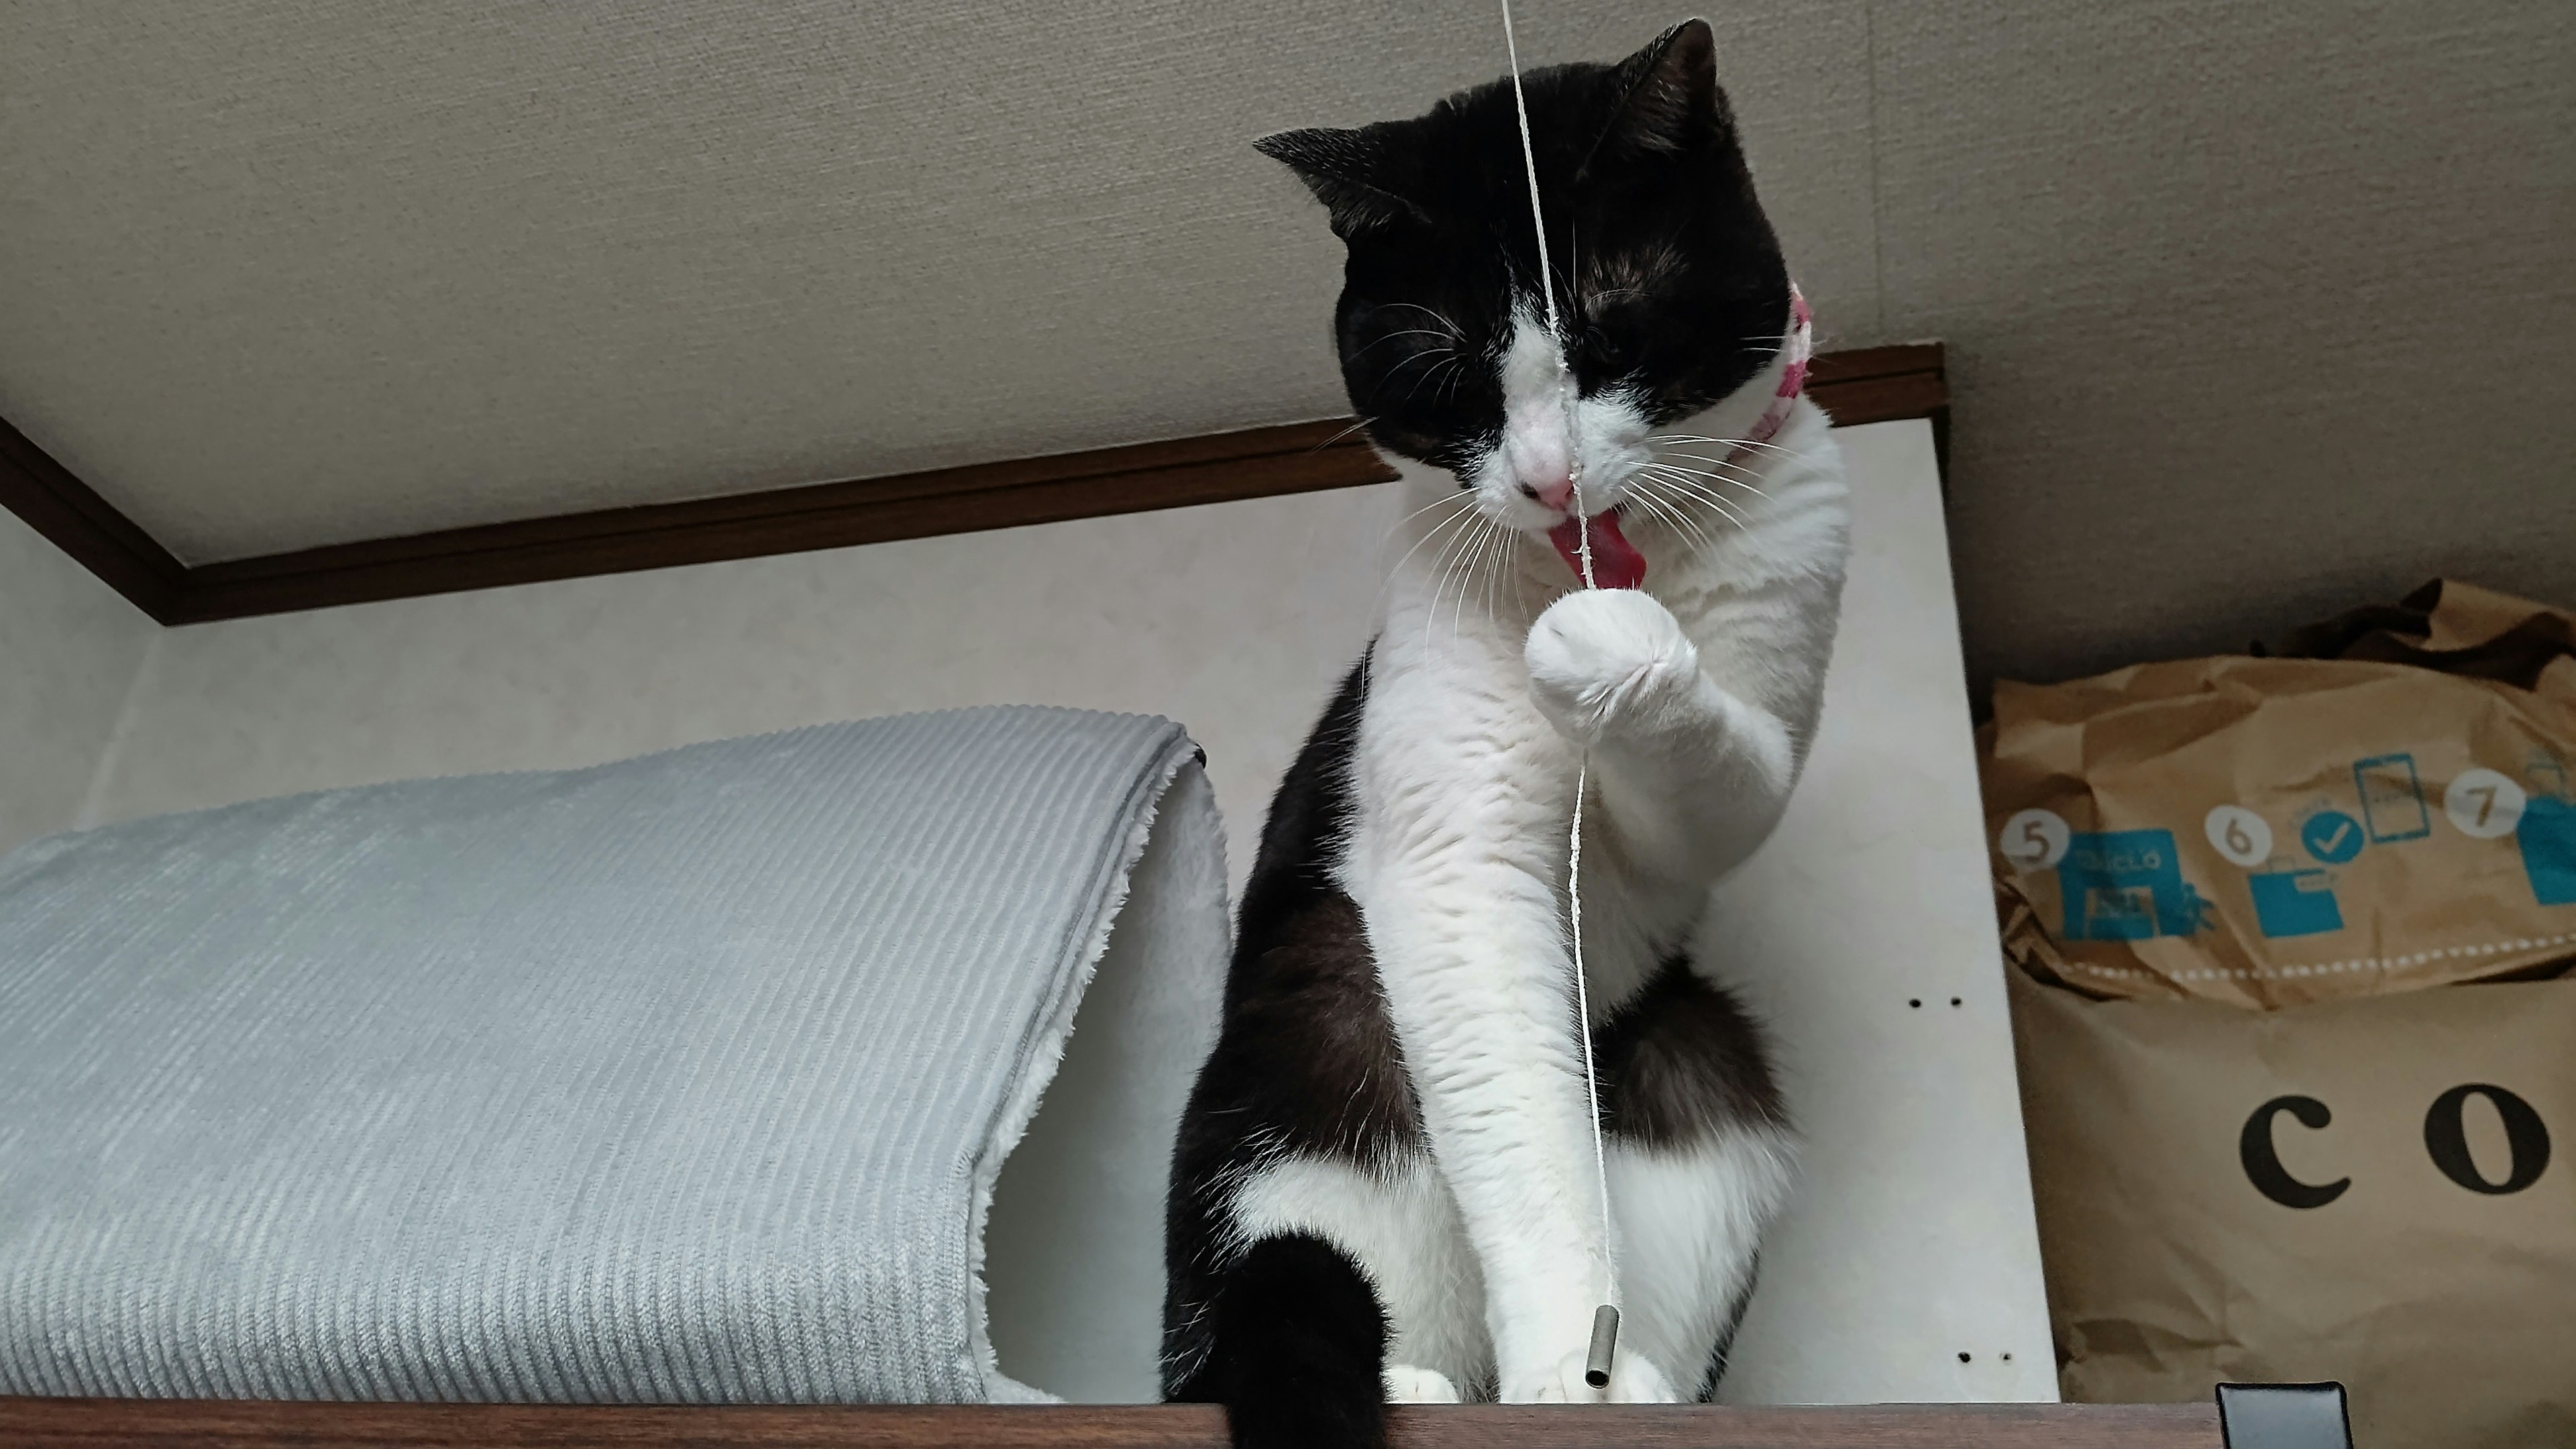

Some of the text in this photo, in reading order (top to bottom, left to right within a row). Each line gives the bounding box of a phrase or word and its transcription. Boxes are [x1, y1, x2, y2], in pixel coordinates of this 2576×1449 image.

[2465, 783, 2496, 827] 7
[2022, 820, 2051, 863] 5
[2224, 817, 2253, 855] 6
